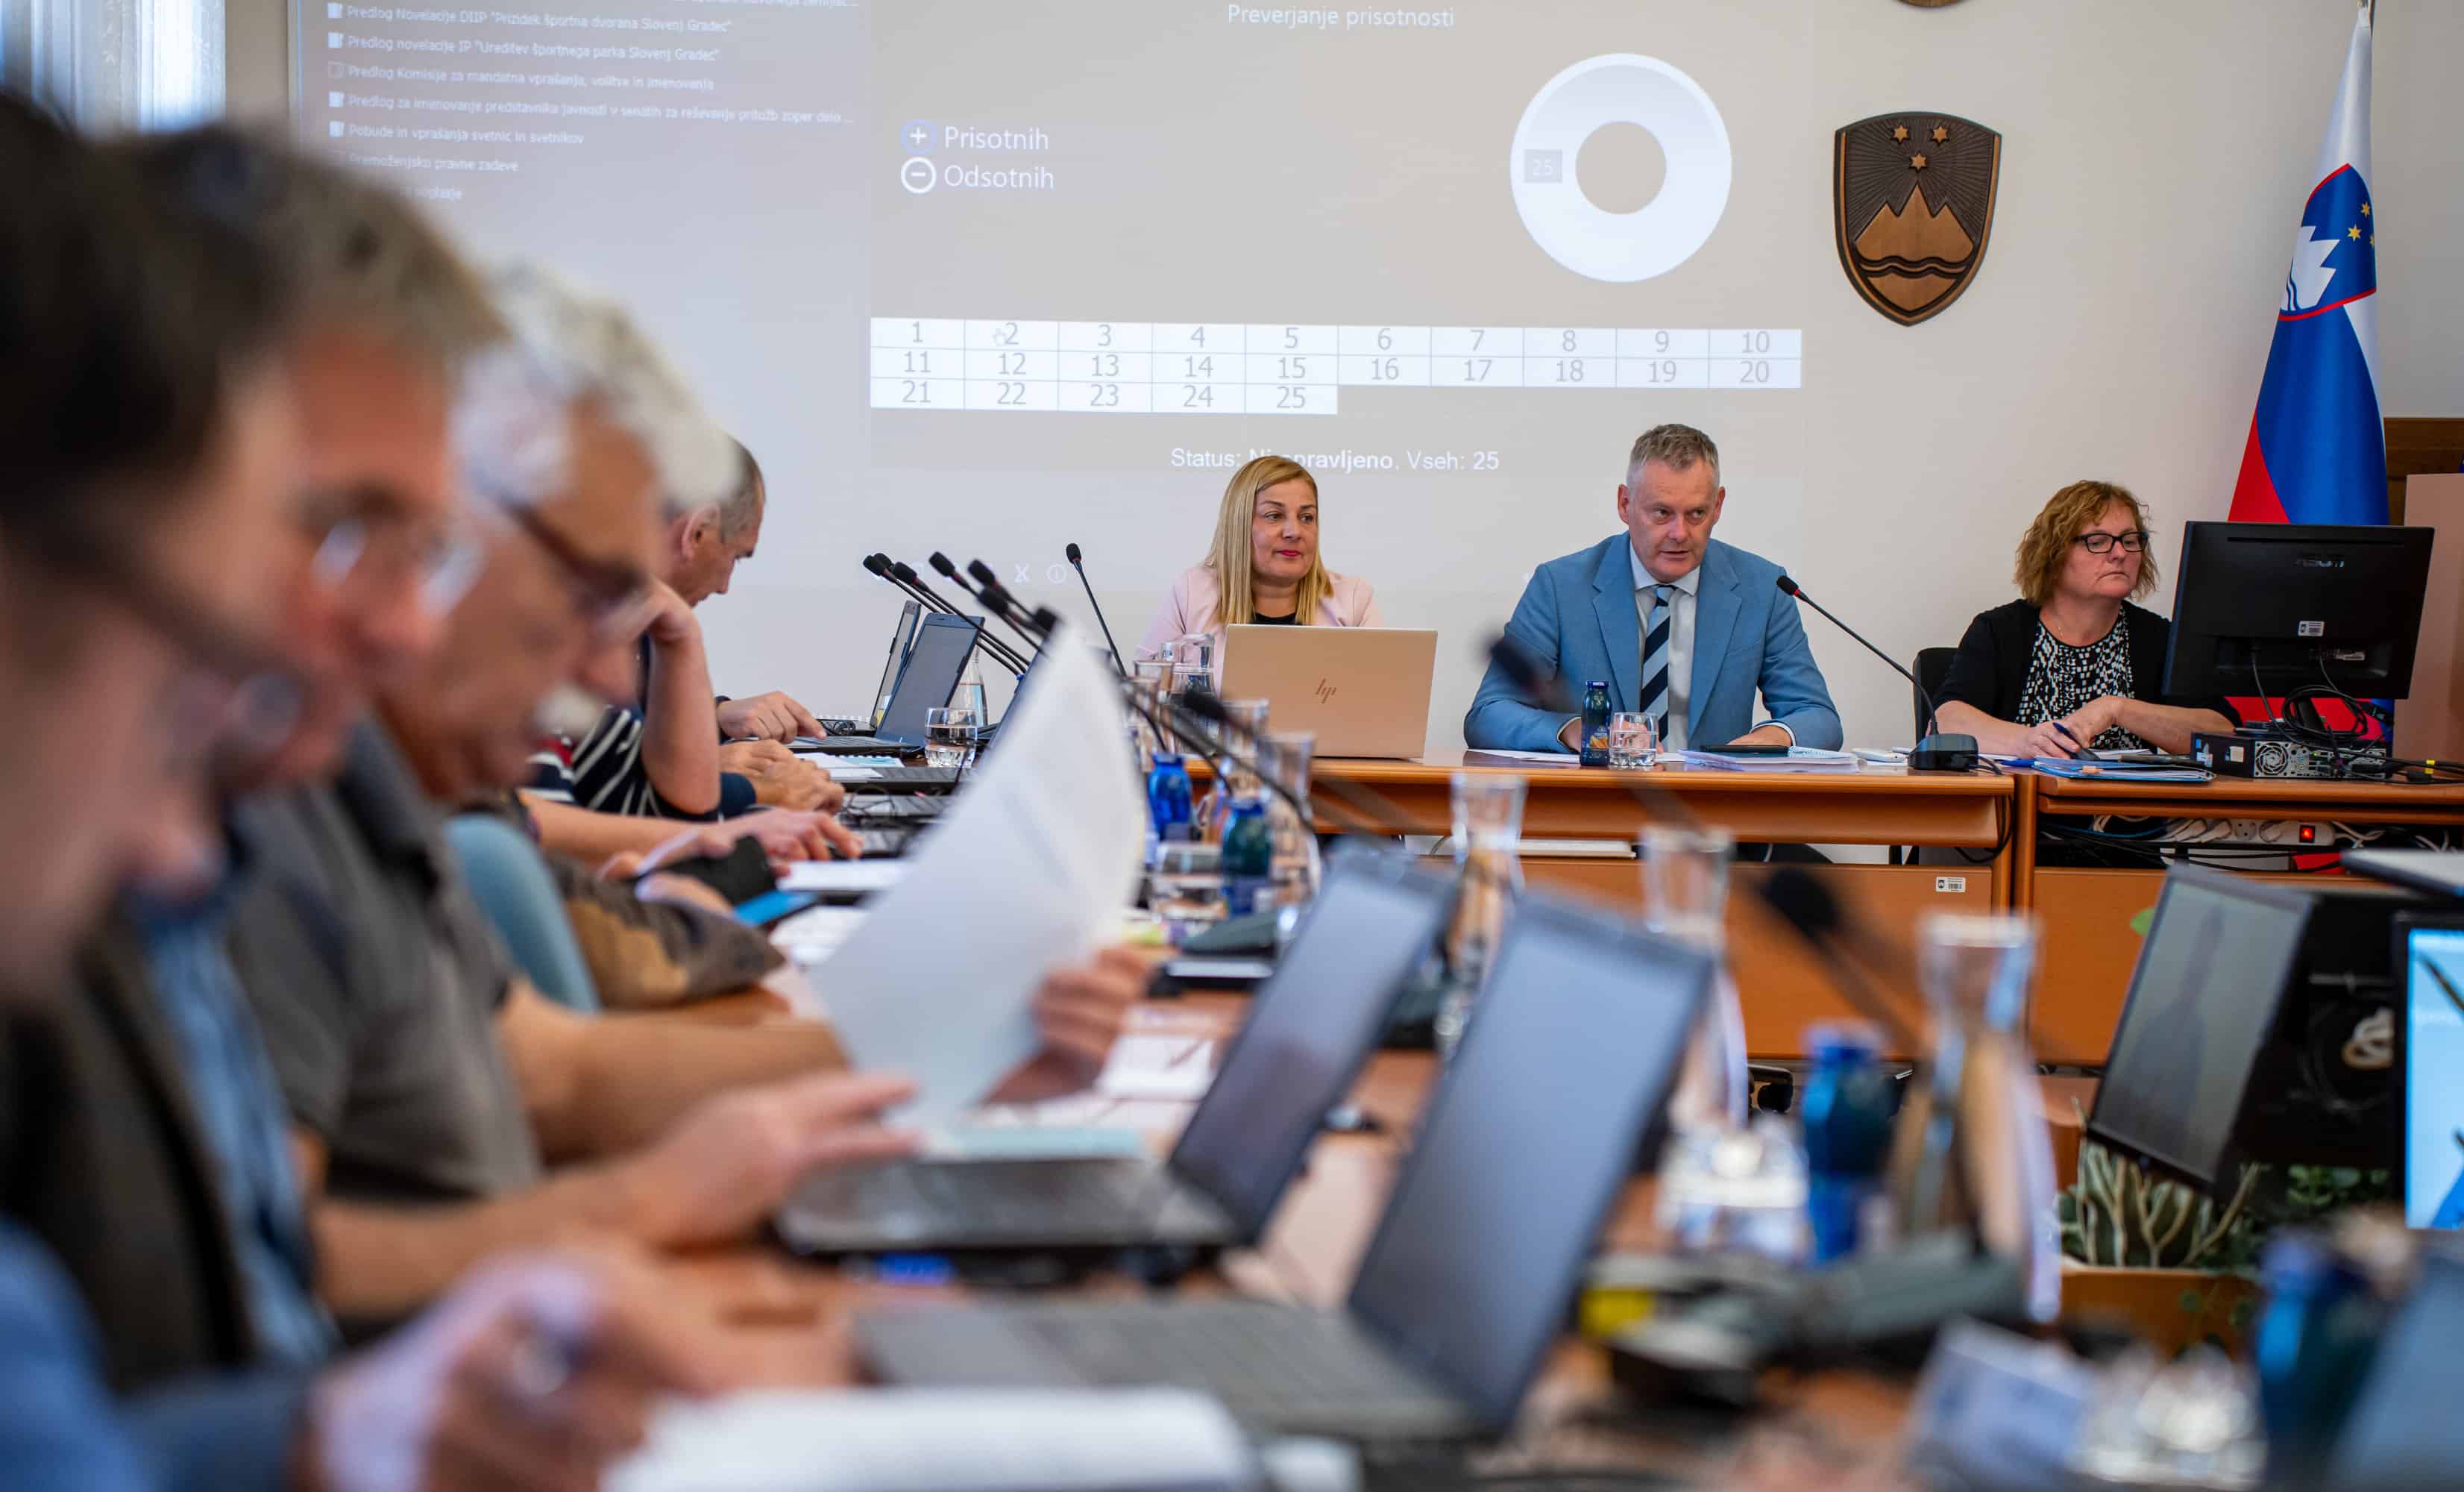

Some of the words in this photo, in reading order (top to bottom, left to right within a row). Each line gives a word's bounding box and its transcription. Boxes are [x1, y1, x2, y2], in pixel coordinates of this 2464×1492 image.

[1228, 4, 1338, 29] Preverjanje
[1346, 6, 1455, 29] prisotnosti
[346, 35, 392, 51] Predlog
[944, 125, 1049, 149] Prisotnih
[944, 164, 1055, 189] Odsotnih
[1532, 159, 1553, 176] 25
[912, 322, 923, 343] 1
[1005, 322, 1019, 345] 2
[1098, 325, 1112, 347] 3
[1191, 326, 1205, 348] 4
[1285, 327, 1298, 349] 5
[1377, 328, 1392, 351] 6
[1471, 329, 1485, 351] 7
[1562, 330, 1577, 351] 8
[1655, 331, 1669, 352] 9
[1742, 332, 1770, 353] 10
[904, 351, 931, 373] 11
[998, 353, 1026, 375] 12
[1091, 354, 1119, 377] 13
[1184, 357, 1213, 378] 14
[1277, 357, 1306, 379] 15
[1371, 359, 1399, 380] 16
[1464, 360, 1492, 381] 17
[1556, 360, 1583, 382] 18
[1649, 362, 1676, 383] 19
[1740, 362, 1769, 383] 20
[902, 381, 931, 404] 21
[997, 383, 1026, 404] 22
[1090, 384, 1119, 407] 23
[1183, 386, 1213, 407] 24
[1277, 386, 1306, 408] 25
[1171, 448, 1242, 467] Status:
[1280, 450, 1400, 473] pravljeno,
[1407, 451, 1465, 470] Vseh:
[1473, 451, 1500, 470] 25
